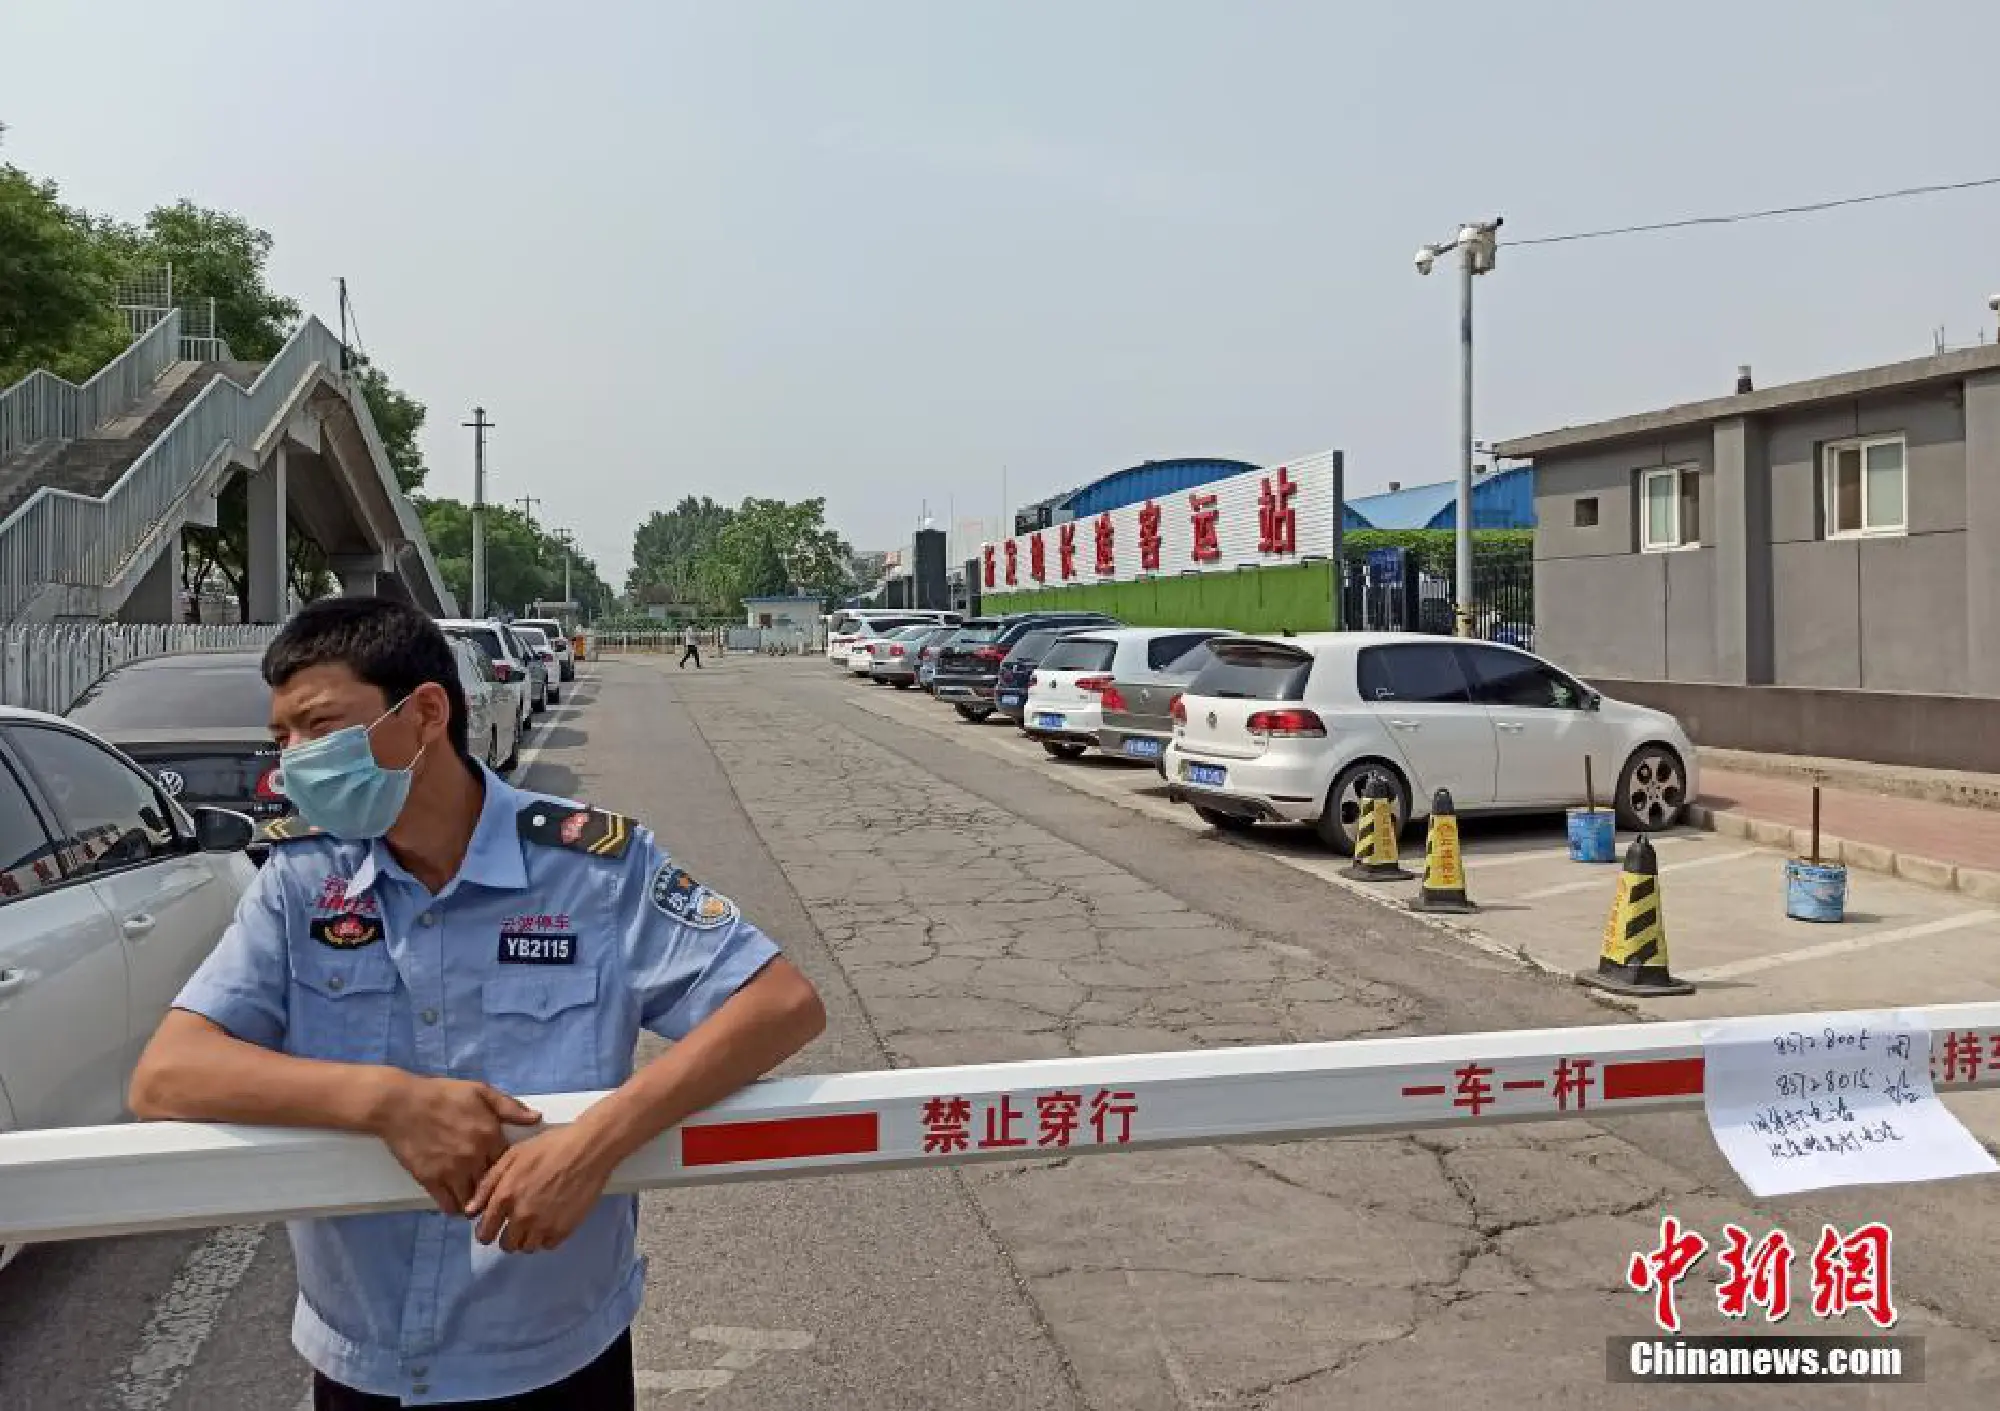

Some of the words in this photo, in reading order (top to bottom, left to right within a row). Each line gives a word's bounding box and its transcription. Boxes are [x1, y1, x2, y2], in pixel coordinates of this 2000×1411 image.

[507, 937, 569, 958] YB2115
[1402, 1057, 1595, 1117] 一车一杆
[922, 1088, 1139, 1154] 禁止穿行
